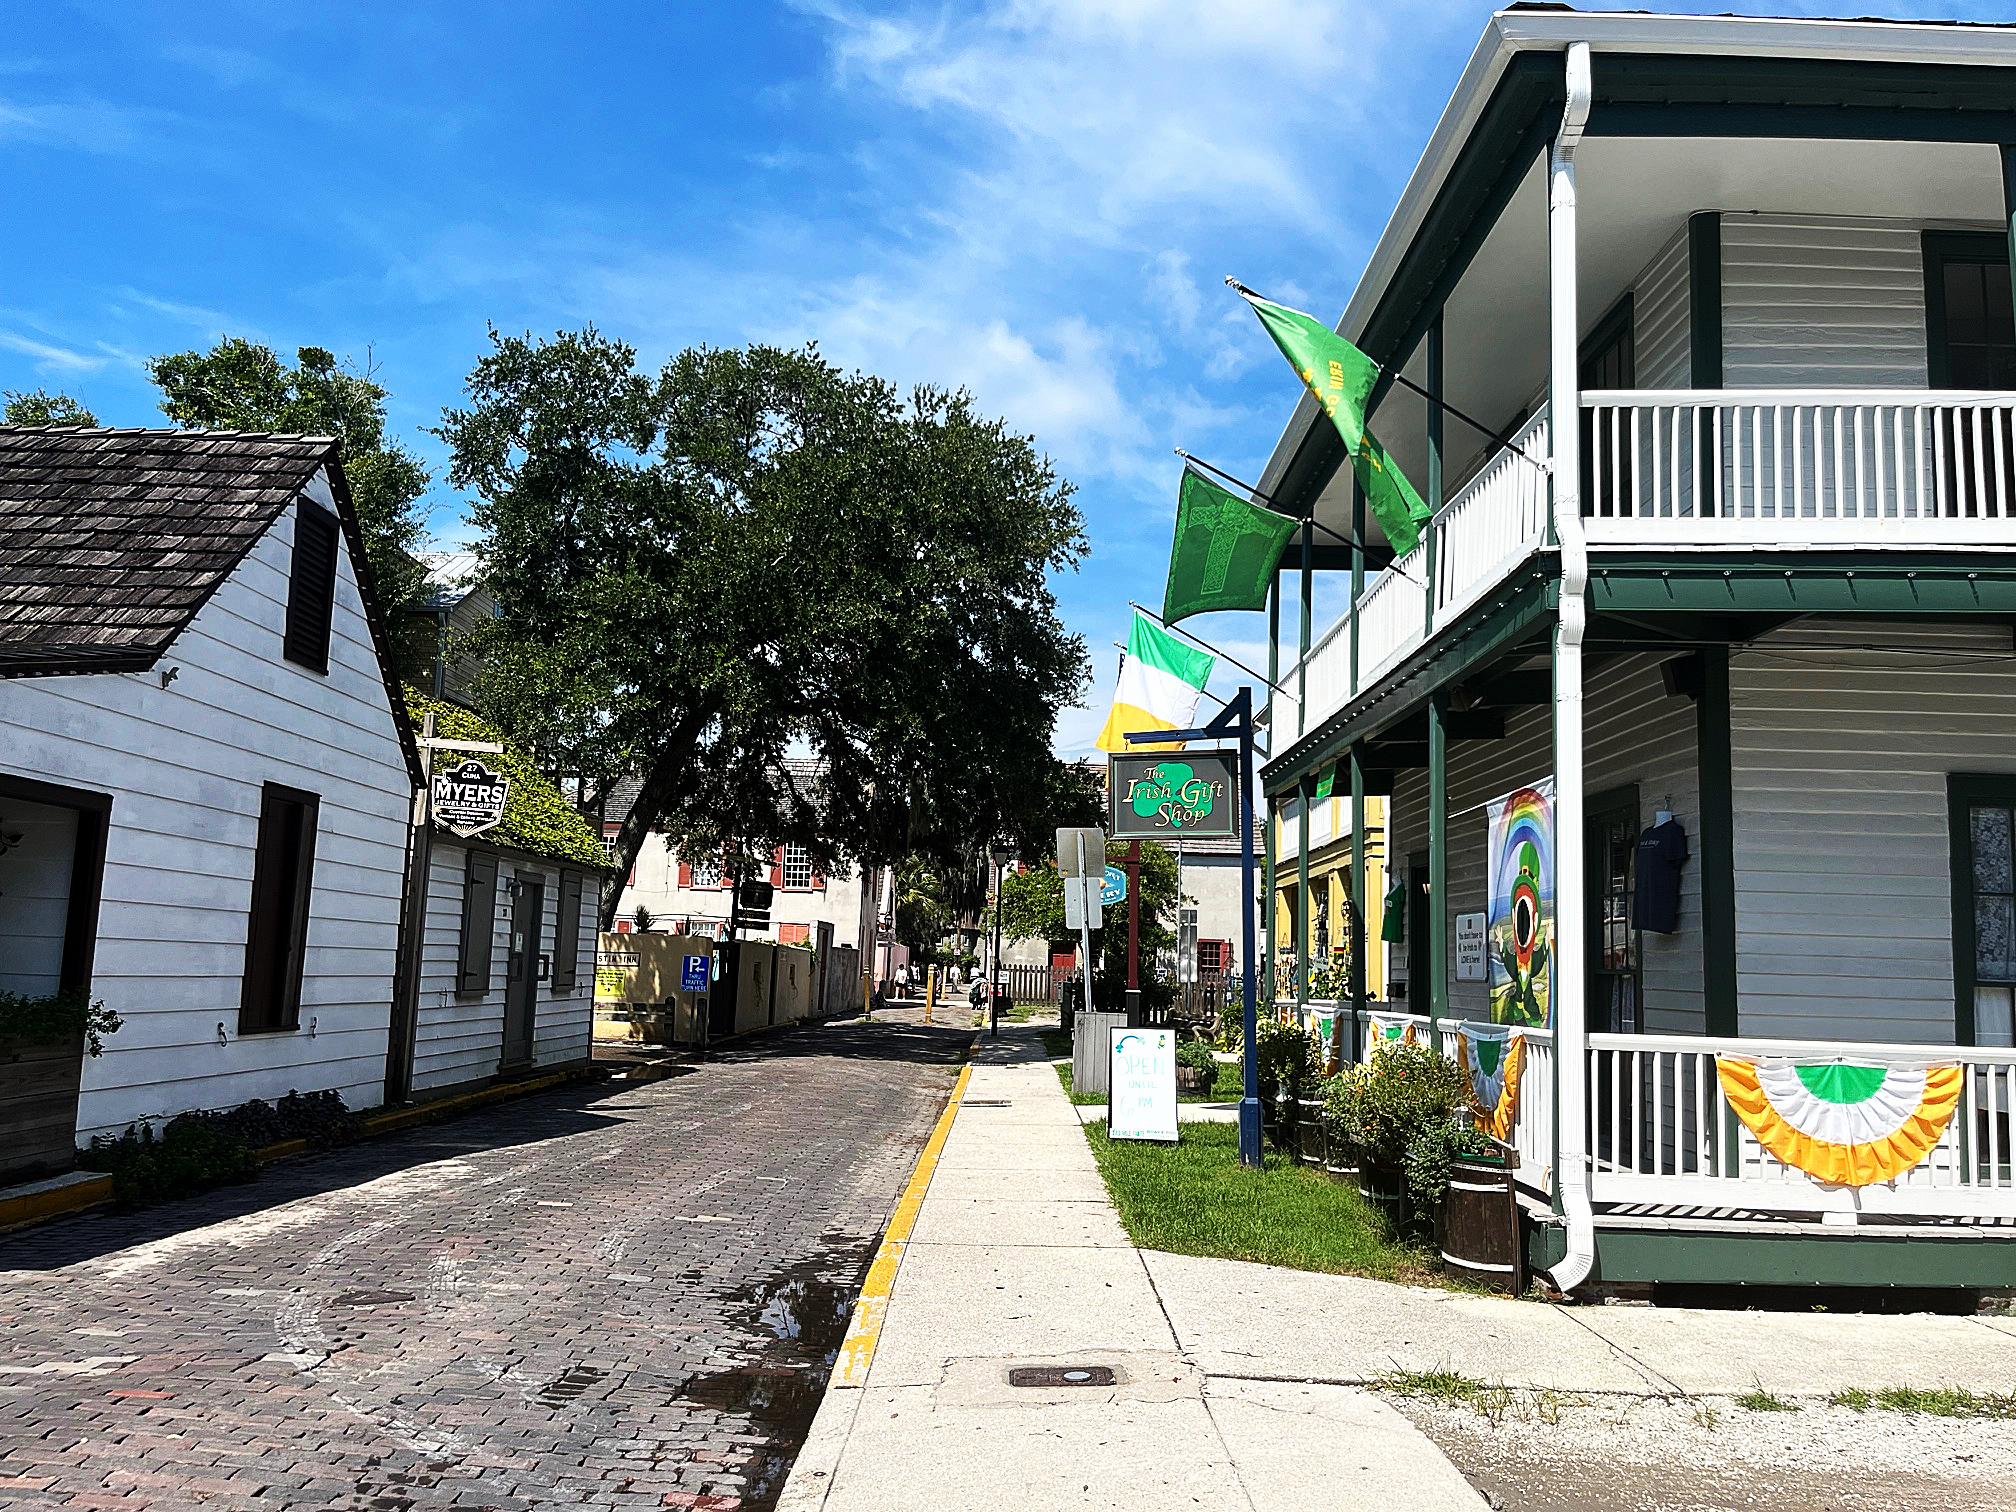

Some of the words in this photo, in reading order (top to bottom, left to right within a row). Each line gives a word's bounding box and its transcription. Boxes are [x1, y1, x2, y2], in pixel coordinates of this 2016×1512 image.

[466, 764, 477, 772] 27
[1143, 767, 1165, 780] The
[435, 781, 504, 803] MYERS
[1121, 779, 1172, 803] Irish
[1181, 778, 1224, 809] Gift
[435, 799, 471, 807] JEWELRY
[478, 802, 500, 810] GIFTS
[1154, 803, 1205, 828] Shop
[689, 956, 701, 973] P
[1115, 1054, 1164, 1076] OPEN
[1128, 1080, 1157, 1089] UNTIL
[1119, 1095, 1135, 1118] 6
[1138, 1096, 1153, 1108] PM
